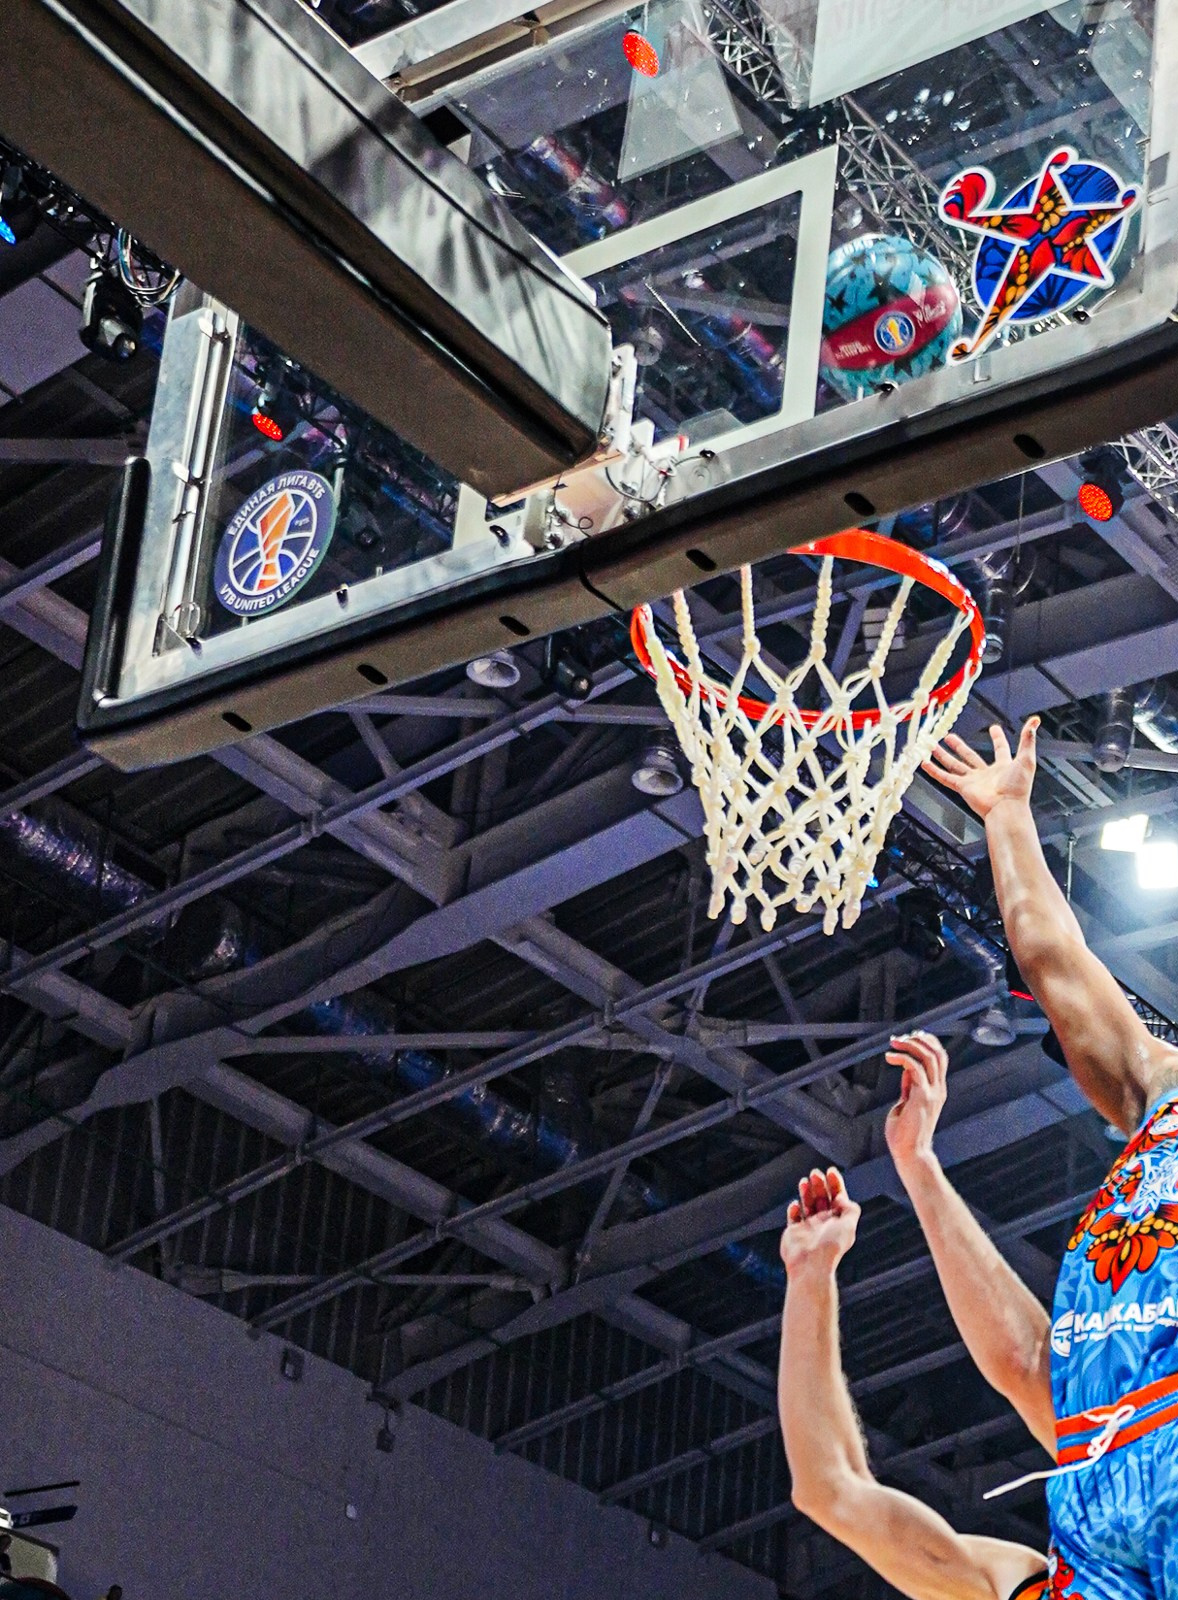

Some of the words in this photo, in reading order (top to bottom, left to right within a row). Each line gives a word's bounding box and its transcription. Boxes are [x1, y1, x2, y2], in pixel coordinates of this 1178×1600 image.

[228, 483, 275, 536] ЕДИНАЯ
[278, 475, 309, 490] ЛИГА
[307, 478, 325, 500] ВТБ
[219, 584, 236, 606] VTB
[234, 595, 275, 610] UNITED
[276, 548, 320, 598] LEAGUE
